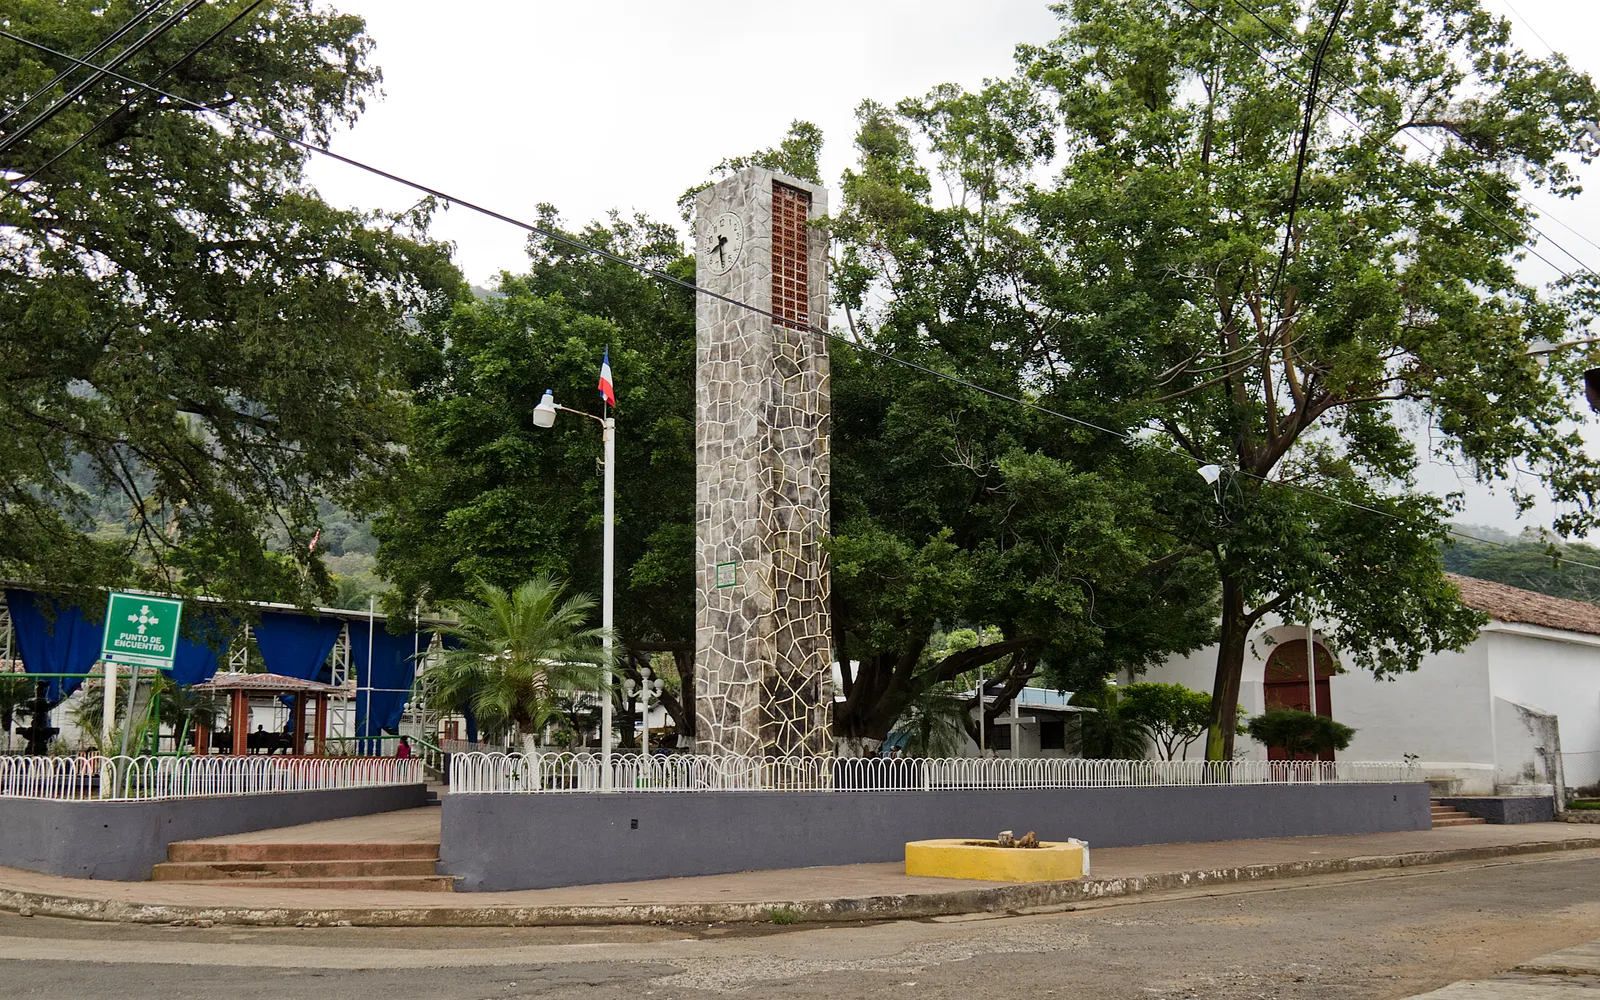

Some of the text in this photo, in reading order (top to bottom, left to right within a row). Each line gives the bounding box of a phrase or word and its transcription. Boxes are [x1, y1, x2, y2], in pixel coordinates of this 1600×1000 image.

[120, 632, 162, 644] PUNTO DE
[114, 639, 165, 652] ENCUENTRO
